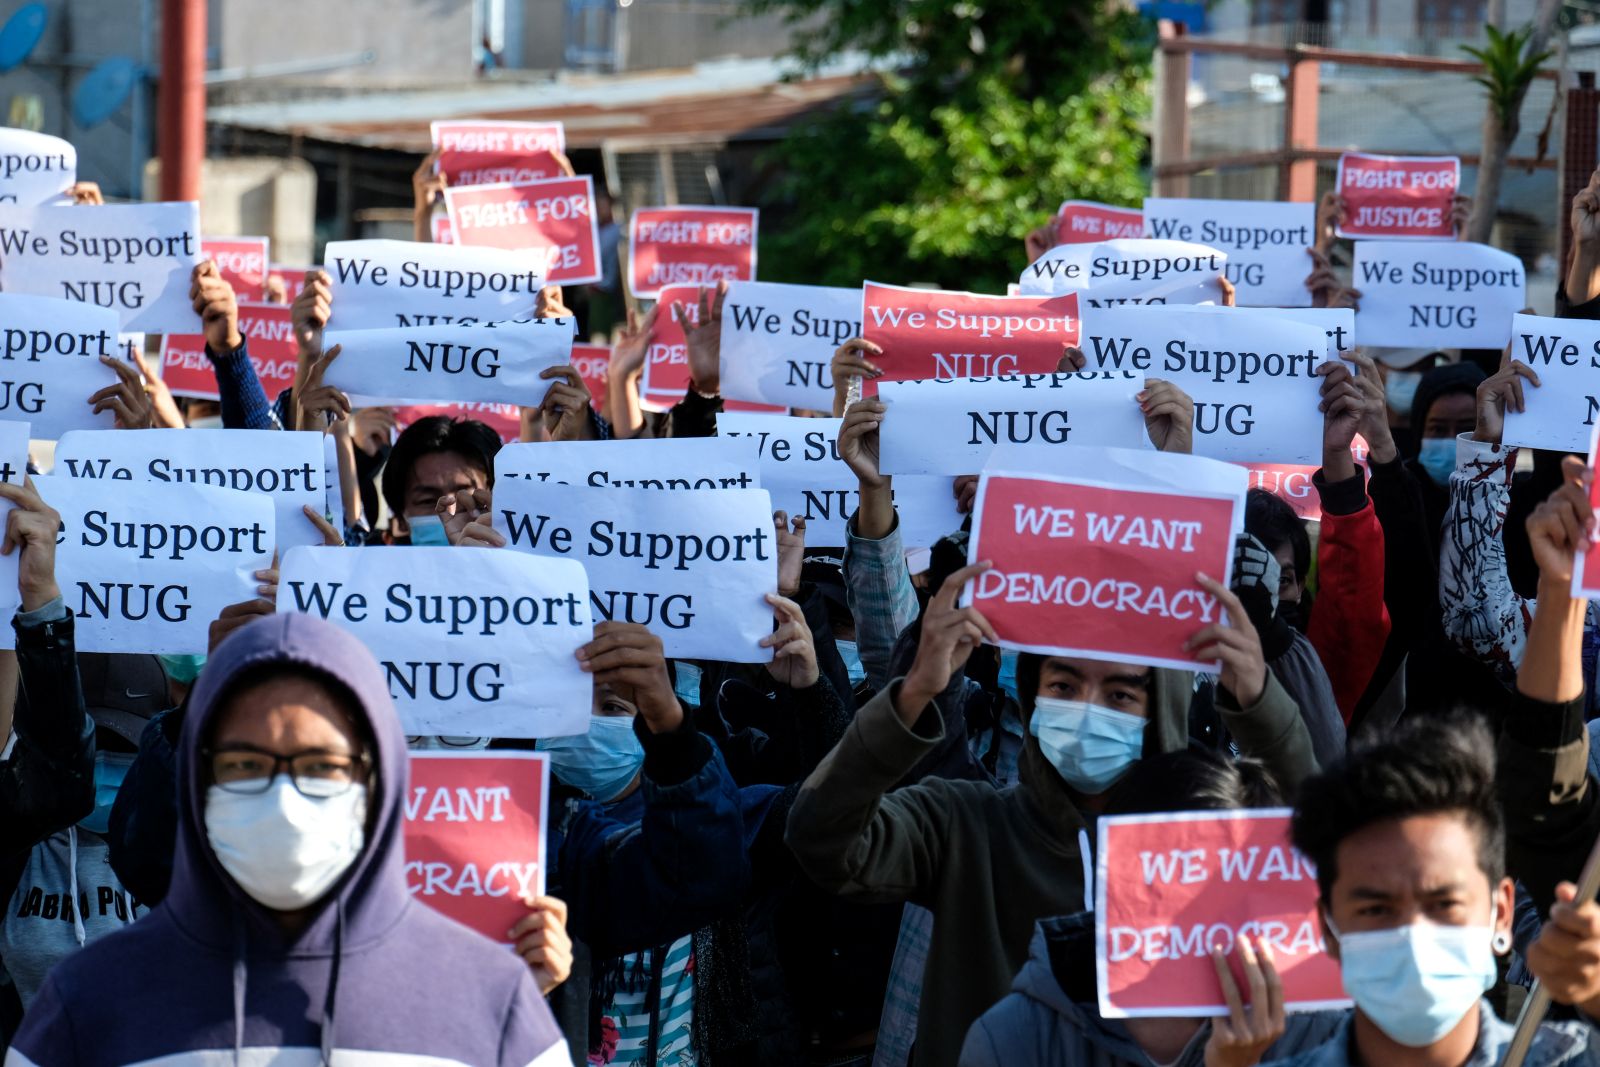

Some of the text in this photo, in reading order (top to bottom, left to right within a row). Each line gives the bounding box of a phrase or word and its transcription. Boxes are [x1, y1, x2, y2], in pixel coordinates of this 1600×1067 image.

[442, 131, 556, 152] FIGHT FOR
[0, 153, 69, 179] port
[455, 168, 545, 186] JUSTICE
[1345, 168, 1454, 189] FIGHT FOR
[458, 194, 589, 229] FIGHT FOR
[1354, 206, 1442, 228] JUSTICE
[0, 228, 194, 264] We Support
[638, 220, 750, 245] FIGHT FOR
[1151, 218, 1308, 249] We Support
[335, 258, 538, 298] We Support
[648, 261, 738, 284] JUSTICE
[1033, 252, 1219, 281] We Support
[1225, 264, 1264, 287] UG
[1360, 261, 1520, 292] We Support
[60, 281, 144, 309] NUG
[730, 305, 780, 334] We
[869, 306, 1076, 338] We Support
[1409, 305, 1477, 329] NUG
[0, 329, 111, 362] pport
[405, 341, 501, 378] NUG
[1090, 336, 1151, 370] We
[1164, 340, 1319, 384] Support
[1520, 335, 1579, 366] We
[570, 357, 608, 379] OR
[786, 361, 834, 390] NU
[932, 352, 1020, 378] NUG
[968, 411, 1071, 444] NUG
[1194, 402, 1255, 435] UG
[148, 459, 317, 492] Support
[1248, 469, 1312, 498] UG
[82, 510, 266, 560] Support
[501, 509, 768, 570] We Support
[1013, 504, 1202, 552] WE WANT
[76, 581, 191, 622] NUG
[288, 581, 583, 636] We Support
[589, 590, 695, 630] NUG
[975, 569, 1218, 623] DEMOCRACY
[380, 661, 505, 702] NUG
[404, 860, 539, 898] CRACY
[1140, 846, 1318, 885] WE WAN
[1110, 920, 1326, 962] DEMOCRA
